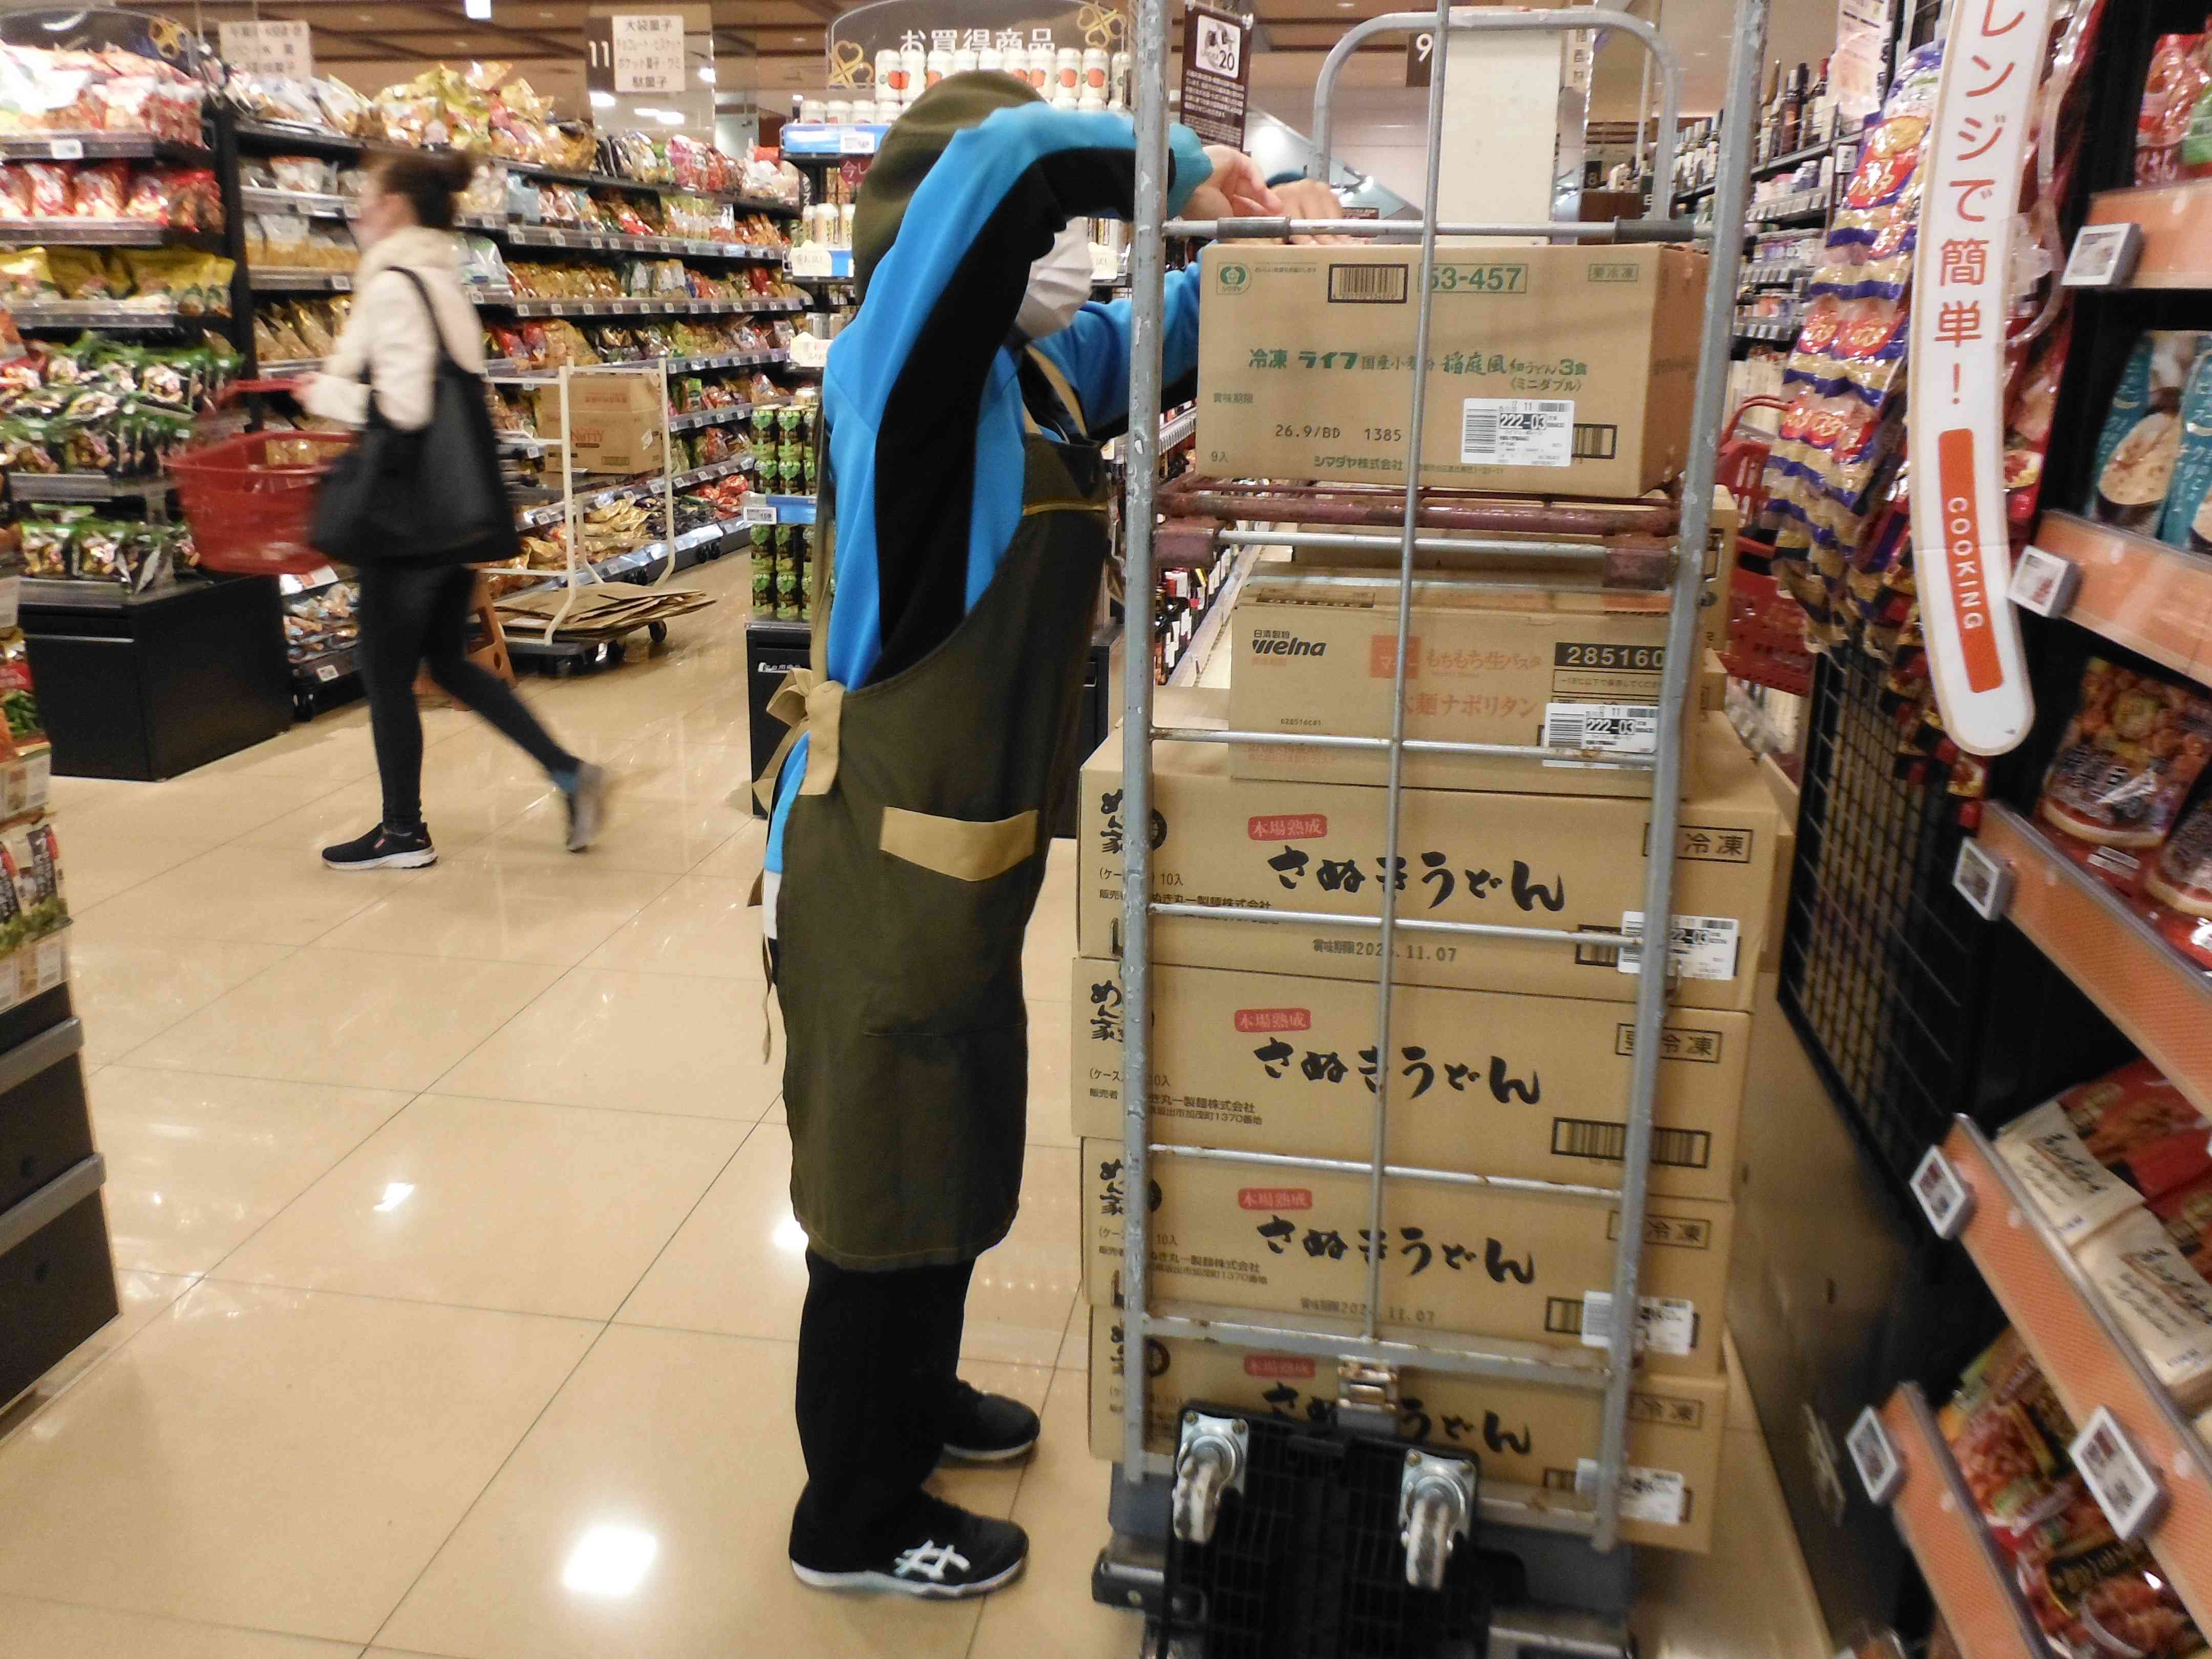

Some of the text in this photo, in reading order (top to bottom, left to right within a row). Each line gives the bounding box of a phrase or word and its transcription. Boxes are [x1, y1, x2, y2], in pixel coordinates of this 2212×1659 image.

[900, 28, 1056, 53] お買得商品
[1416, 33, 1433, 62] 9
[589, 40, 610, 69] 11
[1219, 50, 1235, 71] 20
[1249, 348, 1287, 369] 冷凍
[1299, 351, 1358, 369] ライフ
[1500, 413, 1546, 430] 222-03
[1364, 428, 1402, 441] 1385
[1314, 455, 1403, 471] シマダヤ株式会社
[1947, 496, 1984, 630] COOKING
[1586, 718, 1635, 735] 222-03
[1312, 939, 1457, 962] 賞味期限202.11.07
